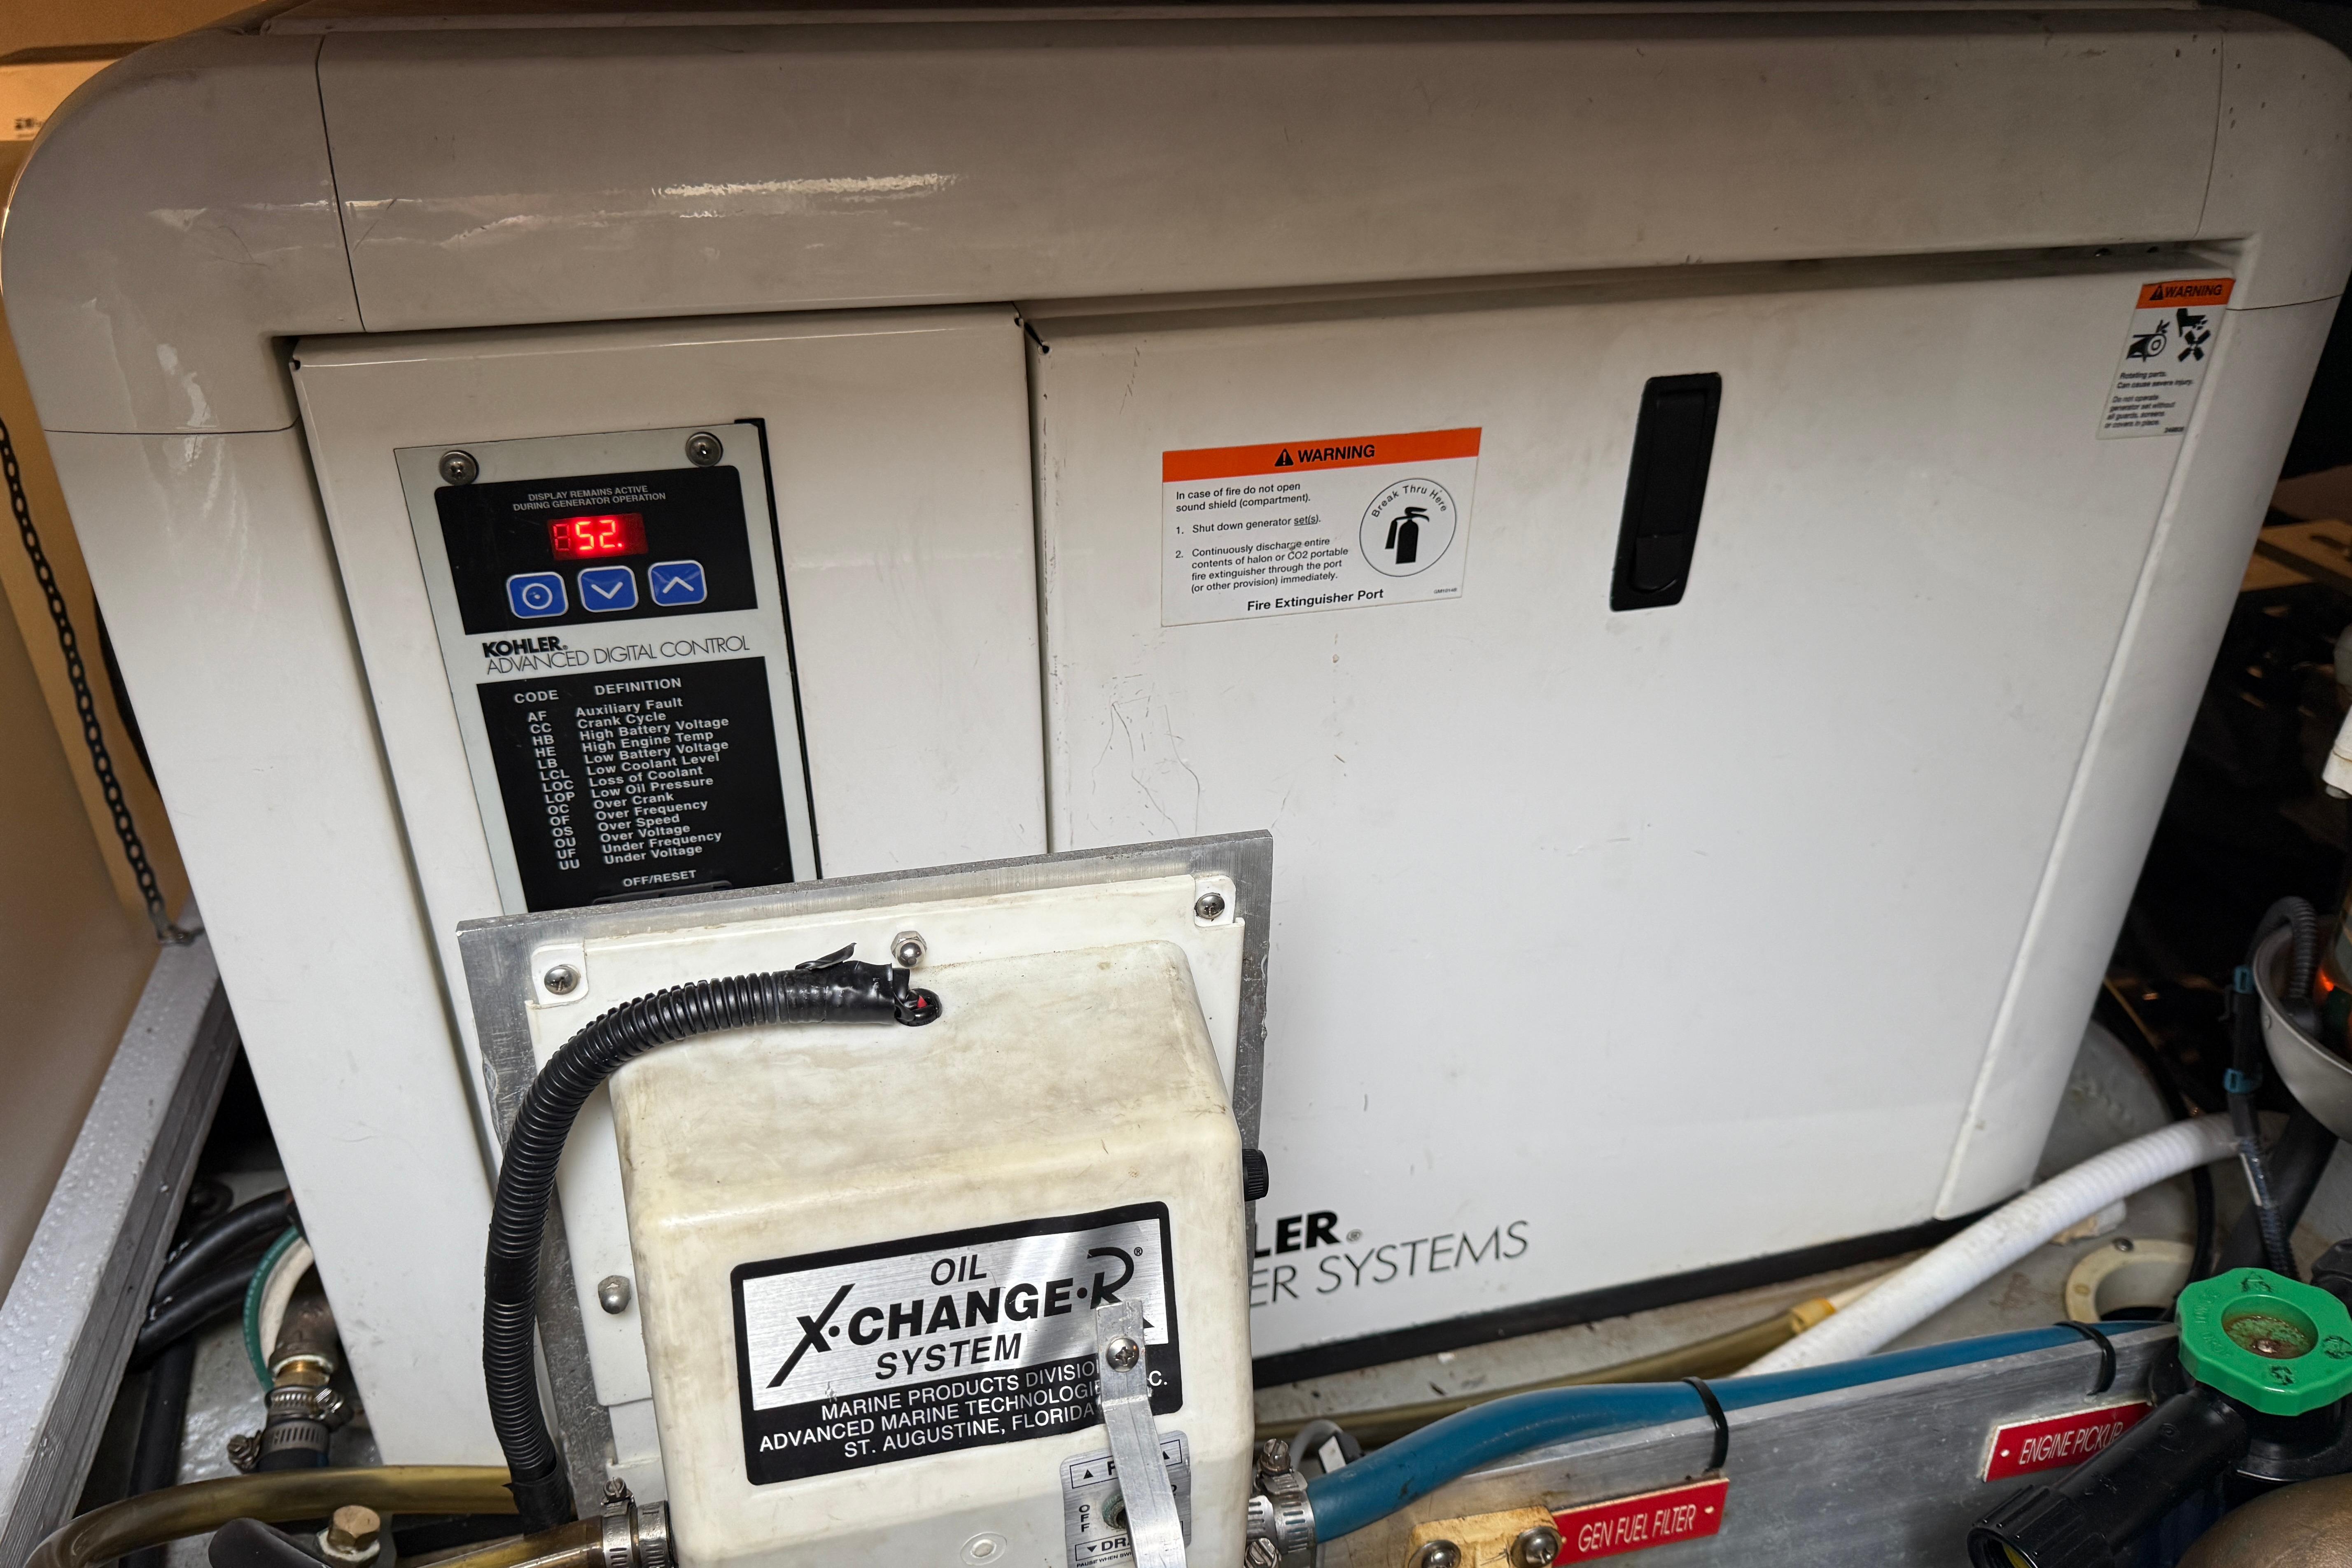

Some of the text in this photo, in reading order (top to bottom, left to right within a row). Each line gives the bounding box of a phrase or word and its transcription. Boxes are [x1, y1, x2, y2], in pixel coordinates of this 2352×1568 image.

[2165, 285, 2223, 297] WARNING
[1297, 445, 1375, 463] WARNING
[513, 493, 666, 511] DURING GENERATOR OPERATION
[528, 485, 648, 502] DISPLAY REMAINS ACTIVE
[1176, 492, 1184, 500] In
[1188, 490, 1210, 499] case
[1226, 487, 1240, 495] fire
[1244, 486, 1255, 494] do
[1259, 485, 1274, 493] not
[1277, 483, 1300, 492] open
[1176, 494, 1311, 512] sound shield (compartment).
[1372, 485, 1446, 517] Break Thru Here
[1192, 524, 1214, 533] Shut
[1217, 522, 1243, 531] down
[1246, 518, 1292, 530] generator
[1294, 514, 1321, 526] set(s).
[1192, 544, 1253, 557] Continuously
[1256, 541, 1302, 552] discharge
[1304, 538, 1330, 547] entire
[1192, 559, 1232, 569] contents
[1247, 555, 1272, 564] halon
[1288, 551, 1308, 560] CO2
[1310, 548, 1348, 560] portable
[1209, 568, 1266, 580] extinguisher
[1269, 563, 1303, 574] through
[1323, 560, 1342, 570] port
[1191, 572, 1338, 594] (or other provision) immediately.
[1247, 589, 1384, 611] Fire Extinguisher Port
[488, 635, 750, 675] ADVANCED DIGITAL CONTROL
[514, 678, 682, 704] CODE DEFINITION
[528, 698, 683, 722] AF Auxiliary Fault
[530, 712, 666, 734] CC Crank Cycle
[532, 718, 729, 746] HB High Battery Voltage
[535, 732, 714, 758] HE High Engine Temp
[537, 742, 729, 769] LB Low Battery Voltage
[540, 753, 719, 781] LCL Low Coolant Level
[543, 766, 703, 792] LOC Loss of Coolant
[546, 778, 714, 804] LOP Low Oil Pressure
[548, 792, 674, 814] OC Over Crank
[550, 801, 708, 826] OF Over Frequency
[553, 814, 680, 837] OS Over Speed
[555, 825, 690, 848] OU Over Voltage
[557, 832, 721, 859] UF Under Frequency
[560, 846, 702, 870] UU Under Voltage
[623, 870, 696, 887] OFF/RESET
[1255, 1209, 1341, 1258] LER
[1316, 1220, 1528, 1294] SYSTEMS
[930, 1254, 987, 1287] OIL
[875, 1333, 1022, 1380] SYSTEM
[821, 1360, 1100, 1421] MARINE PRODUCTS DIVISIO
[759, 1419, 874, 1453] ADVANCED
[882, 1404, 959, 1431] MARINE
[967, 1379, 1100, 1416] TECHNOLOGIE
[844, 1402, 1094, 1458] ST. AUGUSTINE, FLORIDA
[2019, 1422, 2123, 1465] ENGINE PICKUP
[1578, 1504, 1696, 1552] GEN FUEL FILTER
